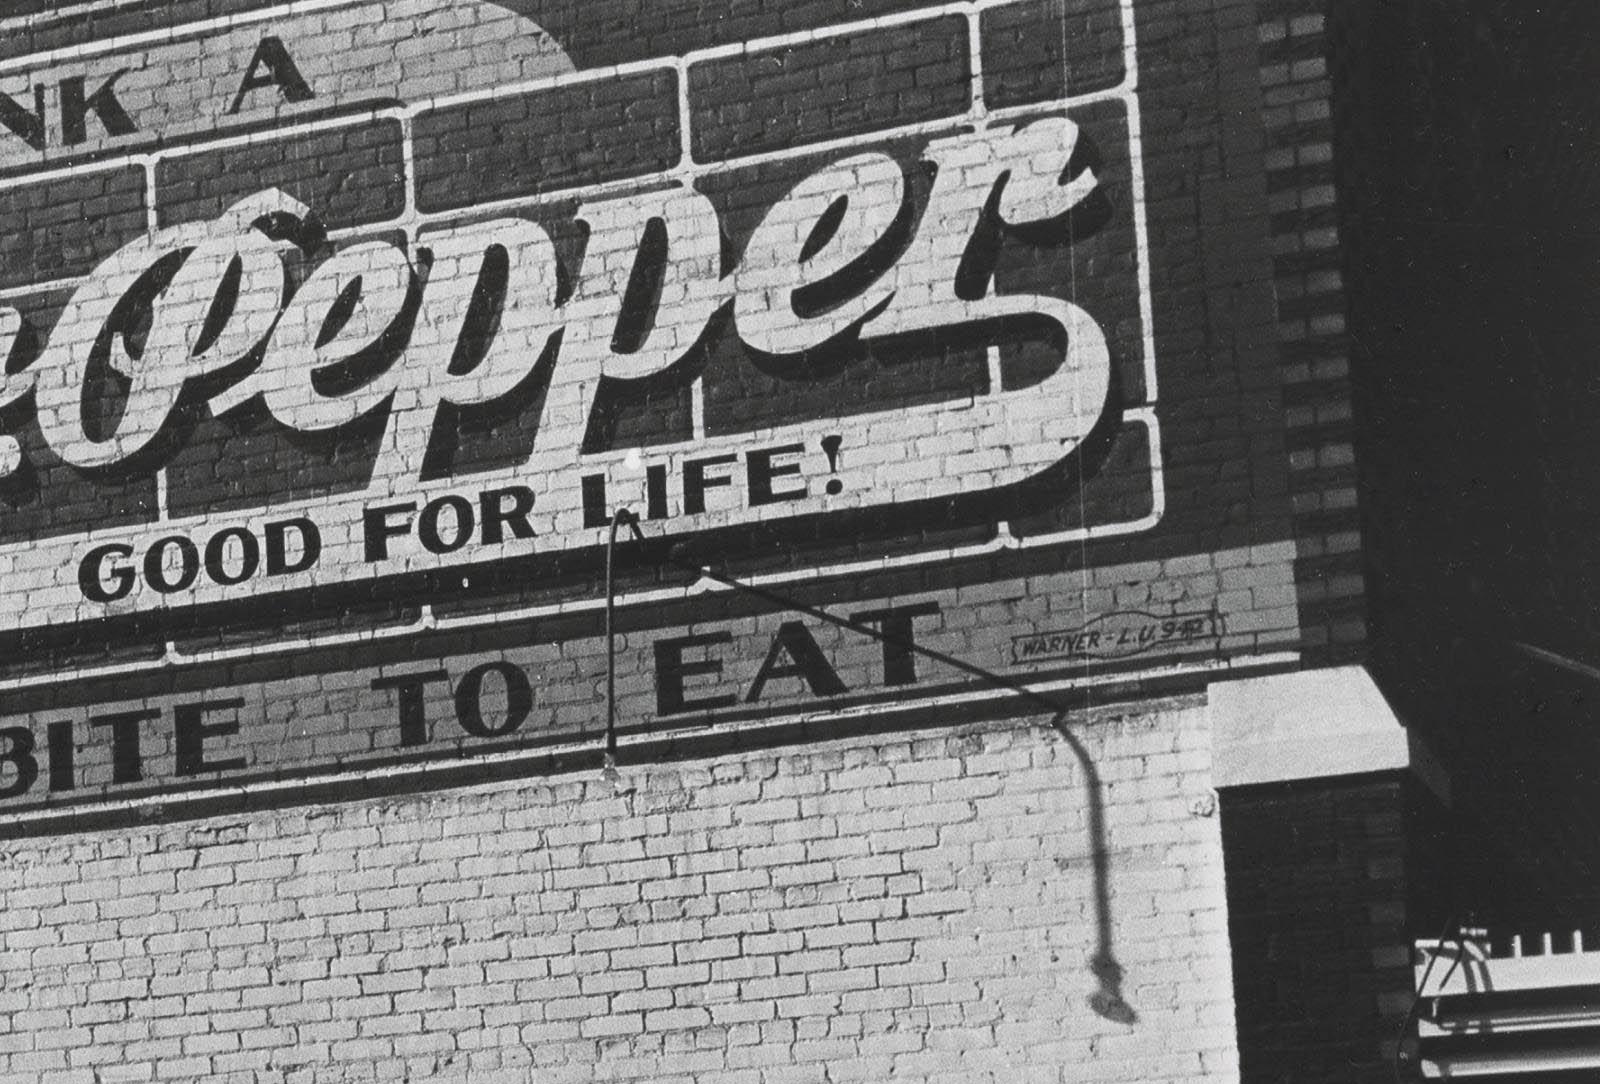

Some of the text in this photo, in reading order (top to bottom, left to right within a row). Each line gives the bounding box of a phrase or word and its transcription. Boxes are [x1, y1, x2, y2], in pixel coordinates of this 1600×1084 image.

[227, 36, 316, 115] A
[77, 434, 844, 603] GOOD FOR LIFE!
[370, 659, 533, 747] TO
[653, 602, 940, 716] EAT
